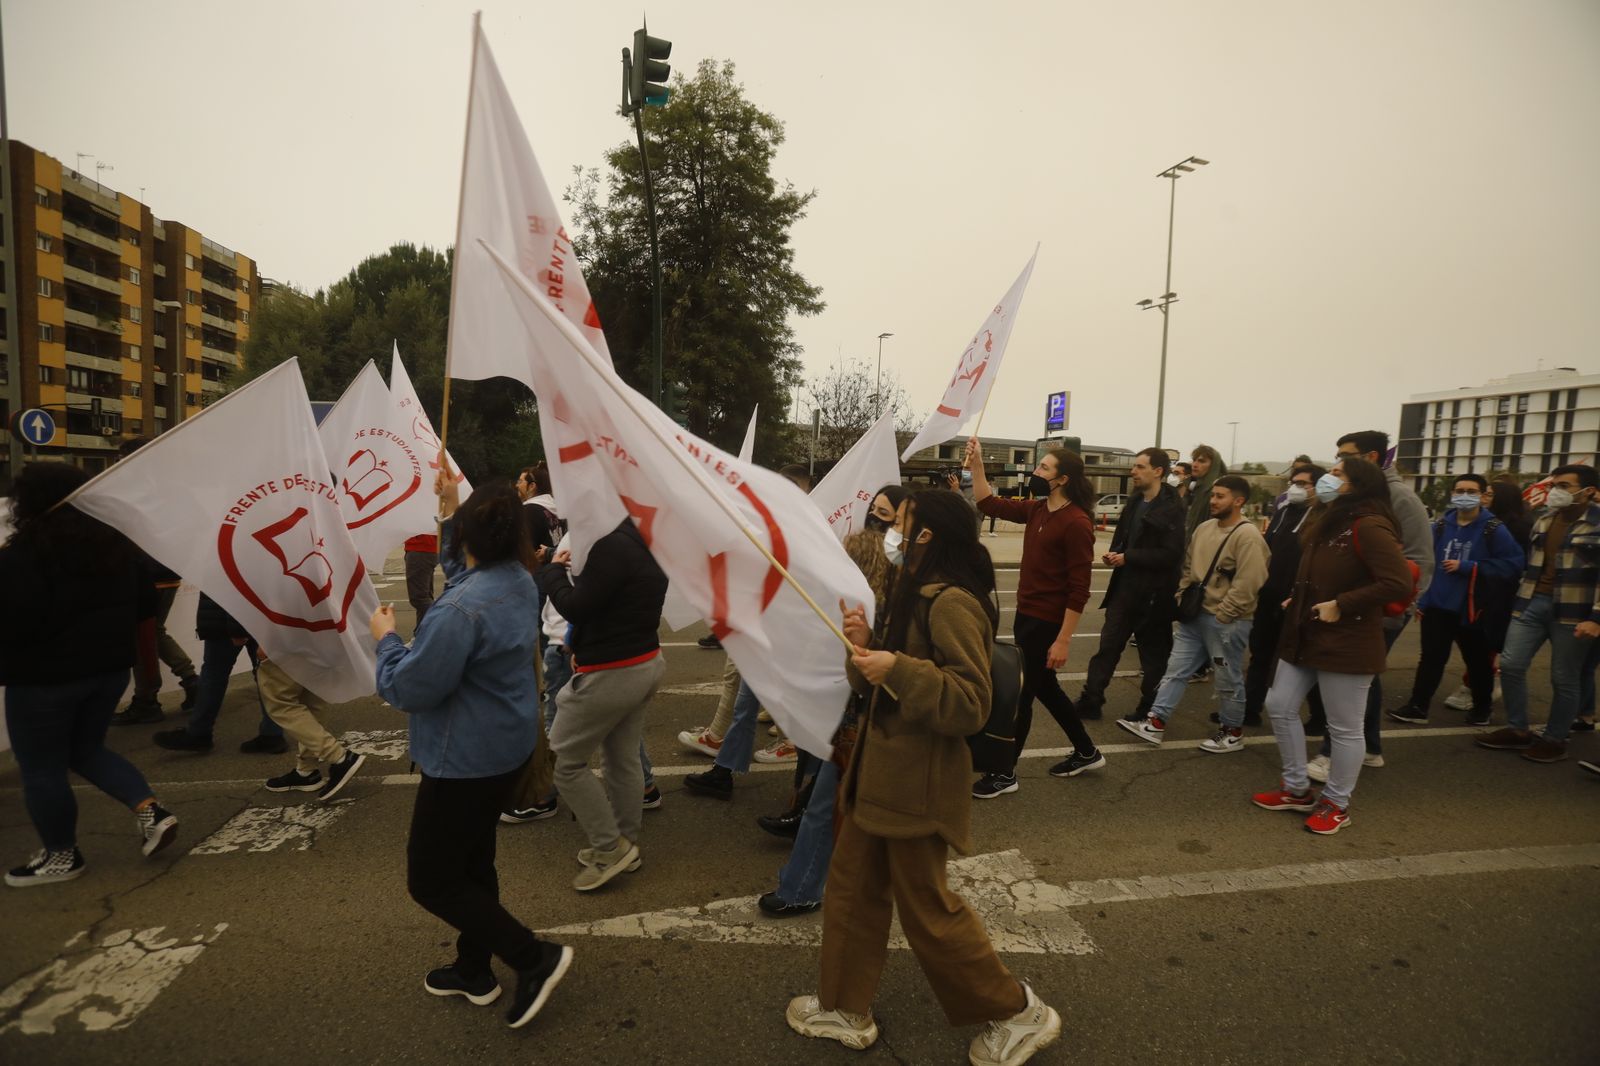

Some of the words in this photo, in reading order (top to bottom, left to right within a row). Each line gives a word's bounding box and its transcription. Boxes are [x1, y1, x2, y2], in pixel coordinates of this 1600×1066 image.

[1050, 394, 1061, 418] P
[369, 427, 422, 477] ESTUDIANTES
[224, 480, 280, 524] FRENTE
[282, 473, 304, 491] DE
[302, 477, 340, 506] ESTU
